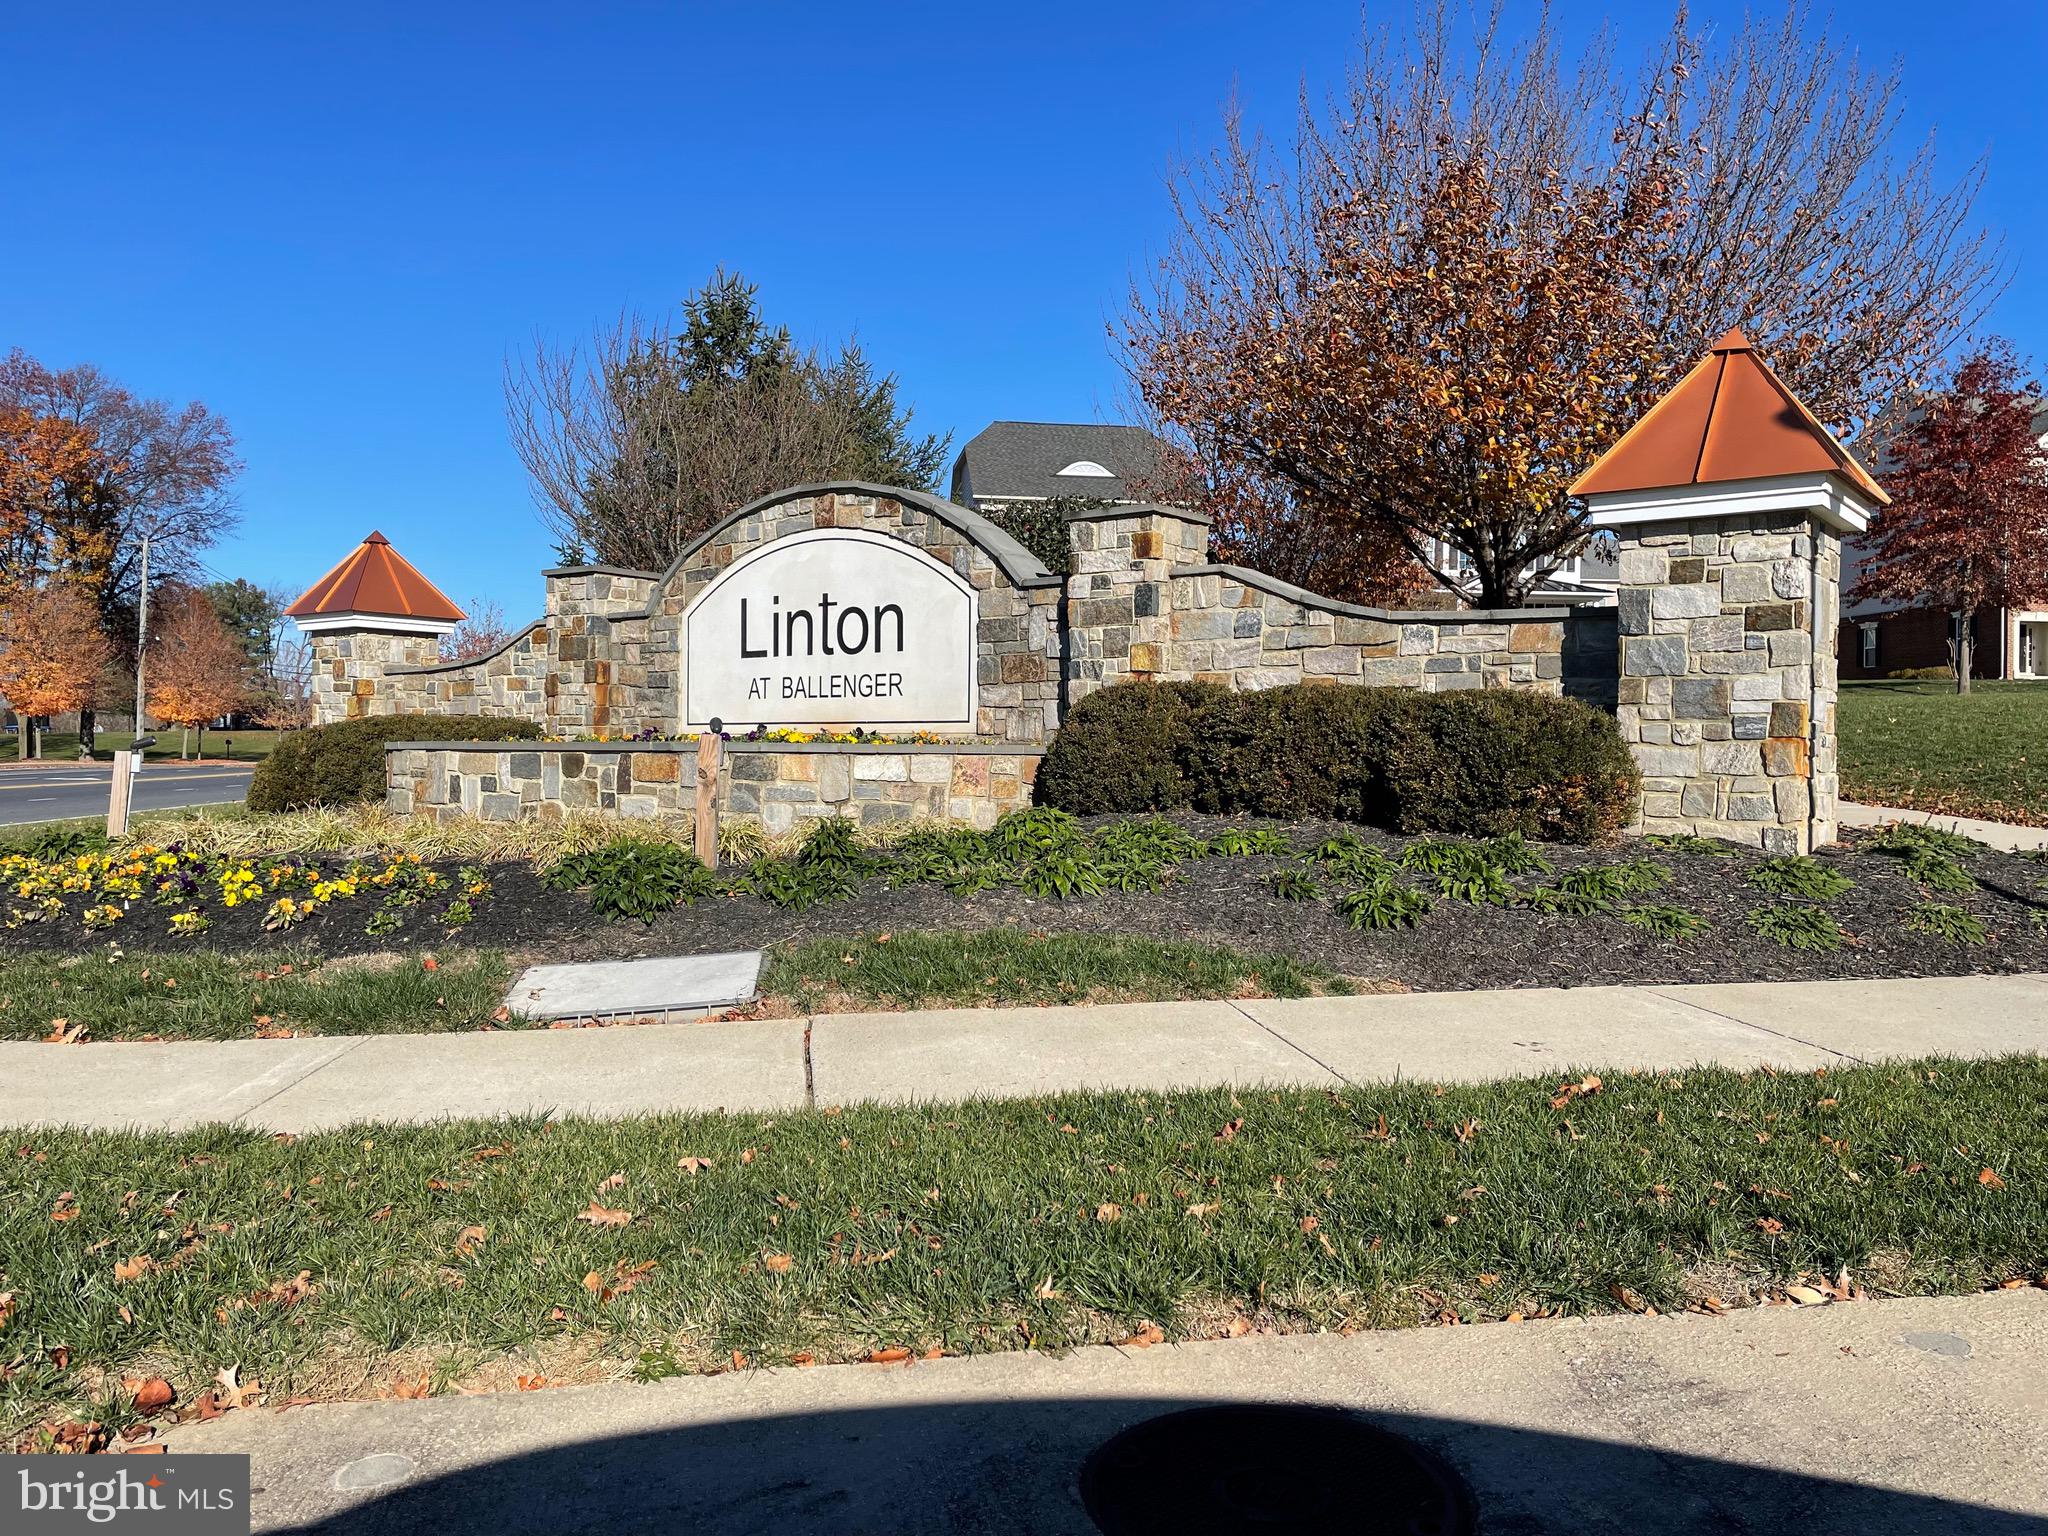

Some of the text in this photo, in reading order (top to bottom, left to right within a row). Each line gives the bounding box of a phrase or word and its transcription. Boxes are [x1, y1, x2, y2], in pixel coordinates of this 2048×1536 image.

[740, 593, 904, 659] Linton
[748, 672, 904, 700] AT BALLENGER
